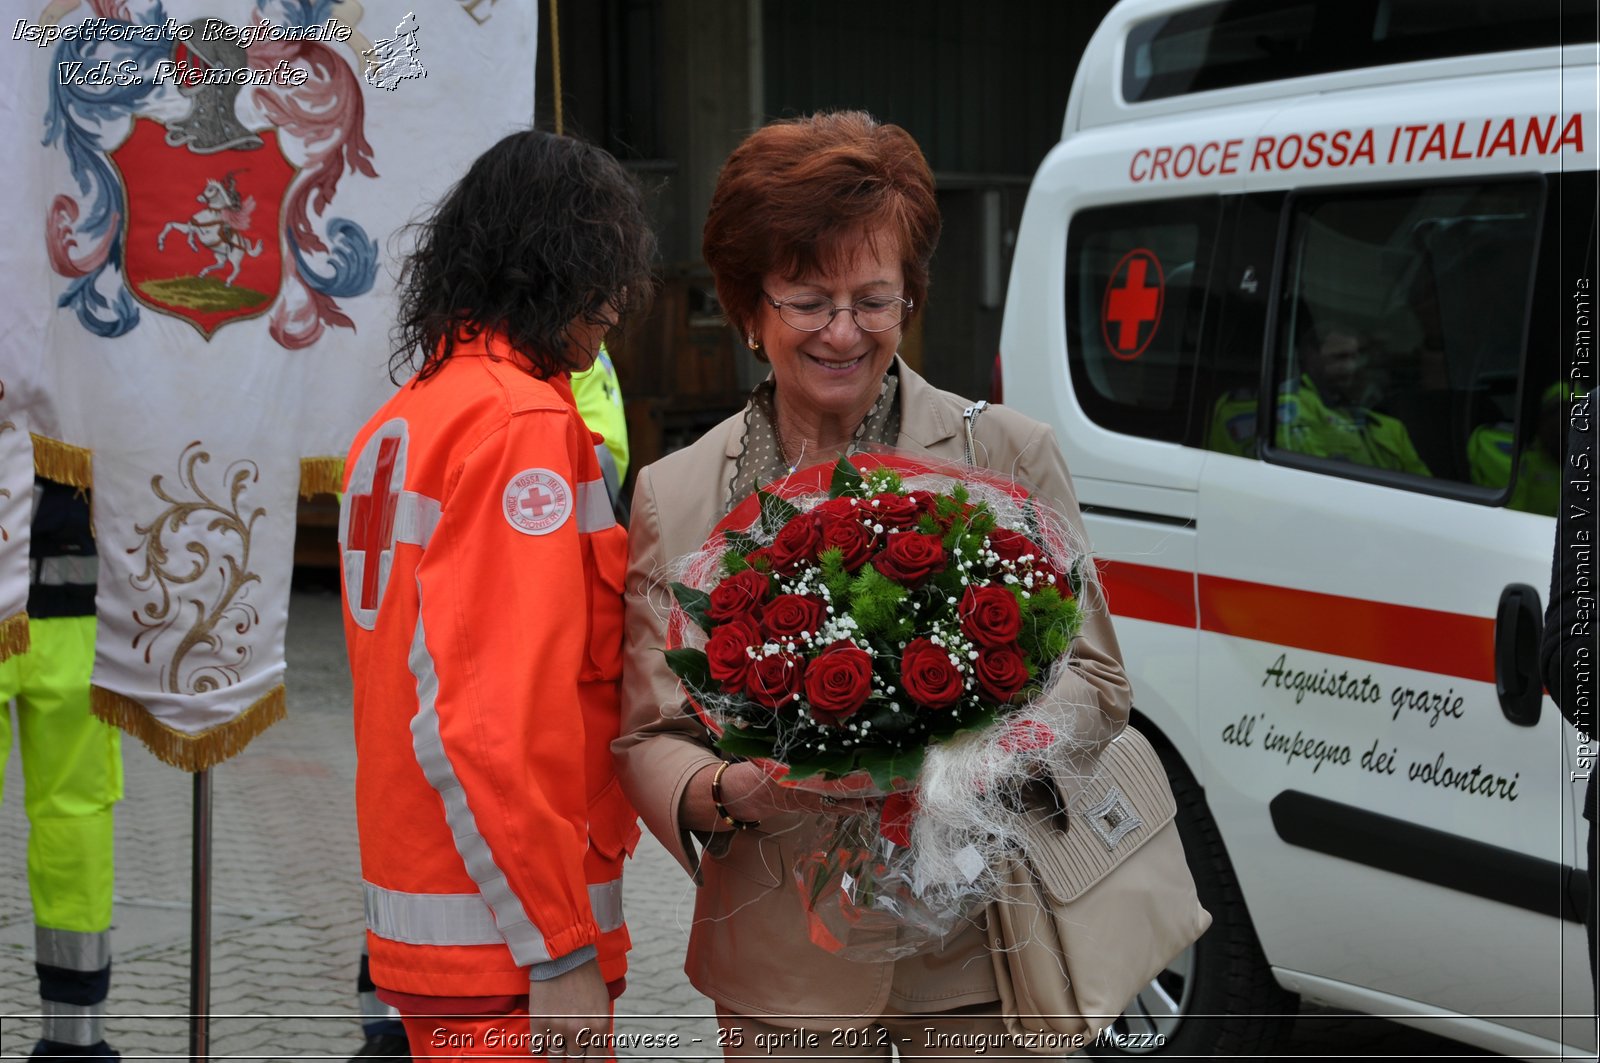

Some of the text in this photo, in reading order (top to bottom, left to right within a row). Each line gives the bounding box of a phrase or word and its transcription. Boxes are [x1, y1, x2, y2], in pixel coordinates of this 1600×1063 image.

[1129, 113, 1585, 183] CROCE ROSSA ITALIANA
[515, 475, 540, 489] ROSSA
[520, 512, 560, 529] PIONIERI
[1261, 653, 1465, 728] Acquistato grazie
[1360, 739, 1398, 775] dei
[1408, 752, 1520, 801] volontari
